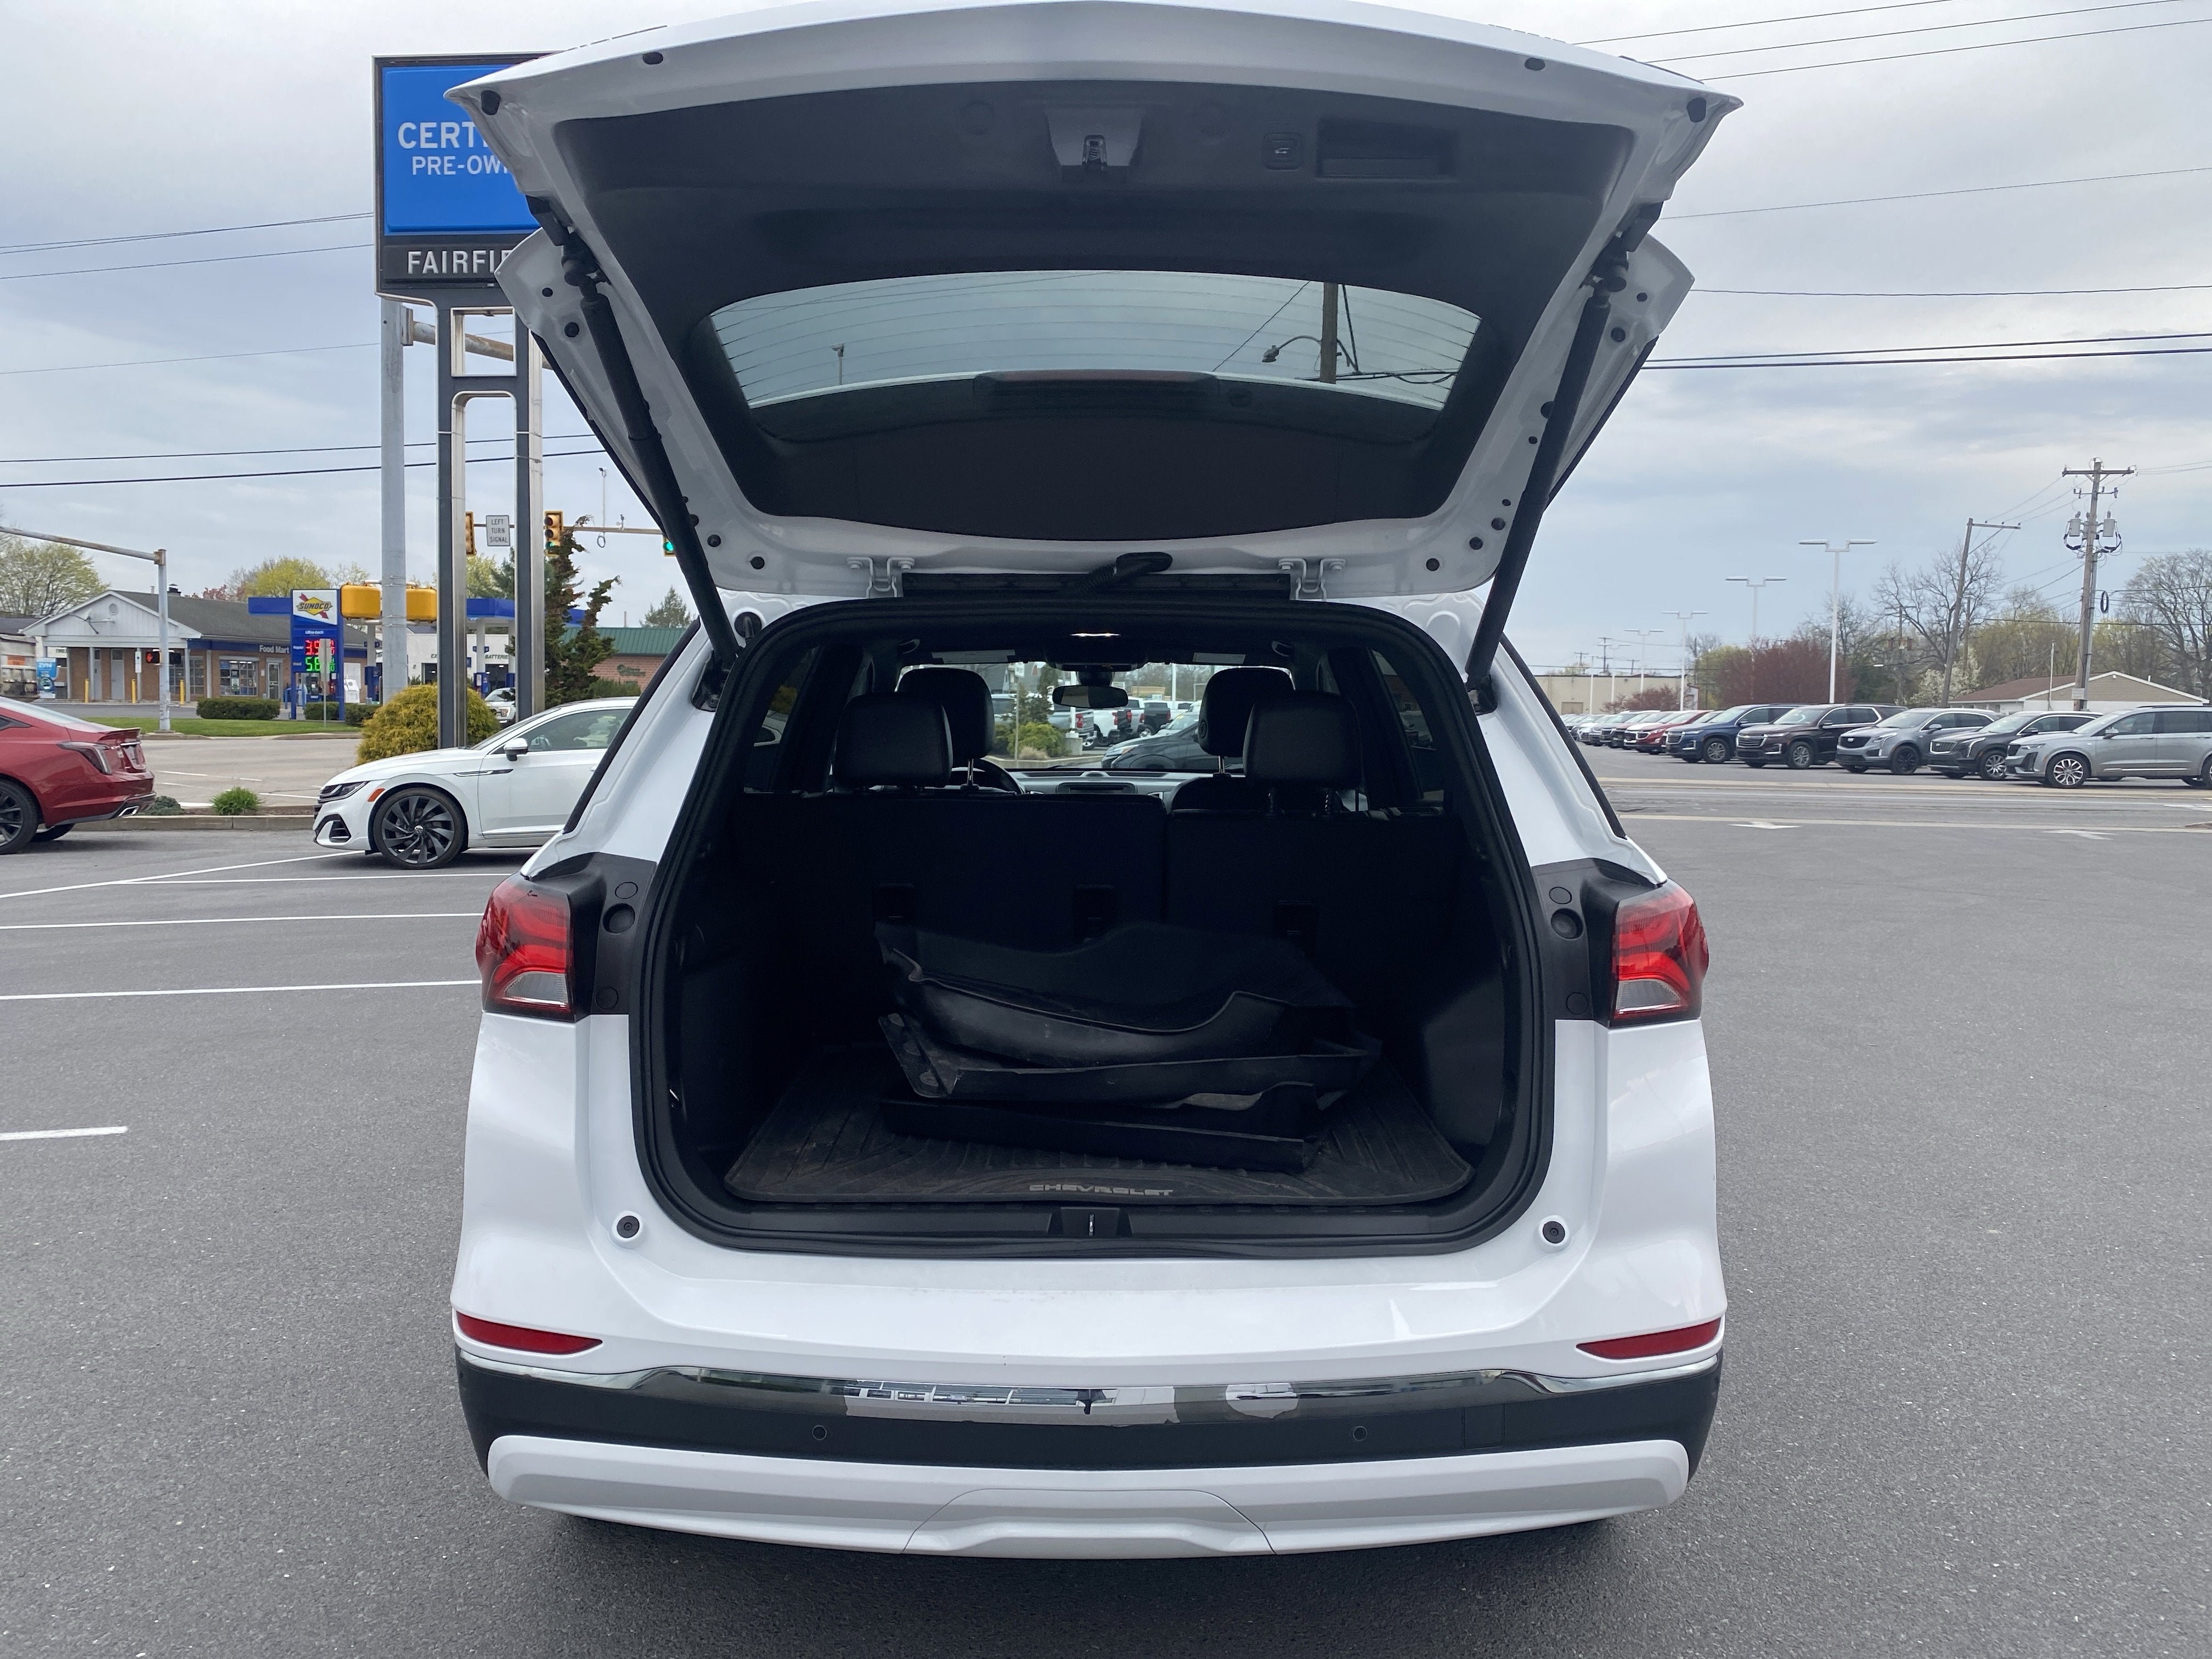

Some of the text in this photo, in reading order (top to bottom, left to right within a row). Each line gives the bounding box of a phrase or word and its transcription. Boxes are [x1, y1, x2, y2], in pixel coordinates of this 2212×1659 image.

[398, 122, 488, 149] CERT
[412, 155, 507, 175] PRE-OW
[259, 645, 290, 654] Food Mart
[1029, 1183, 1173, 1197] CHEVROLET
